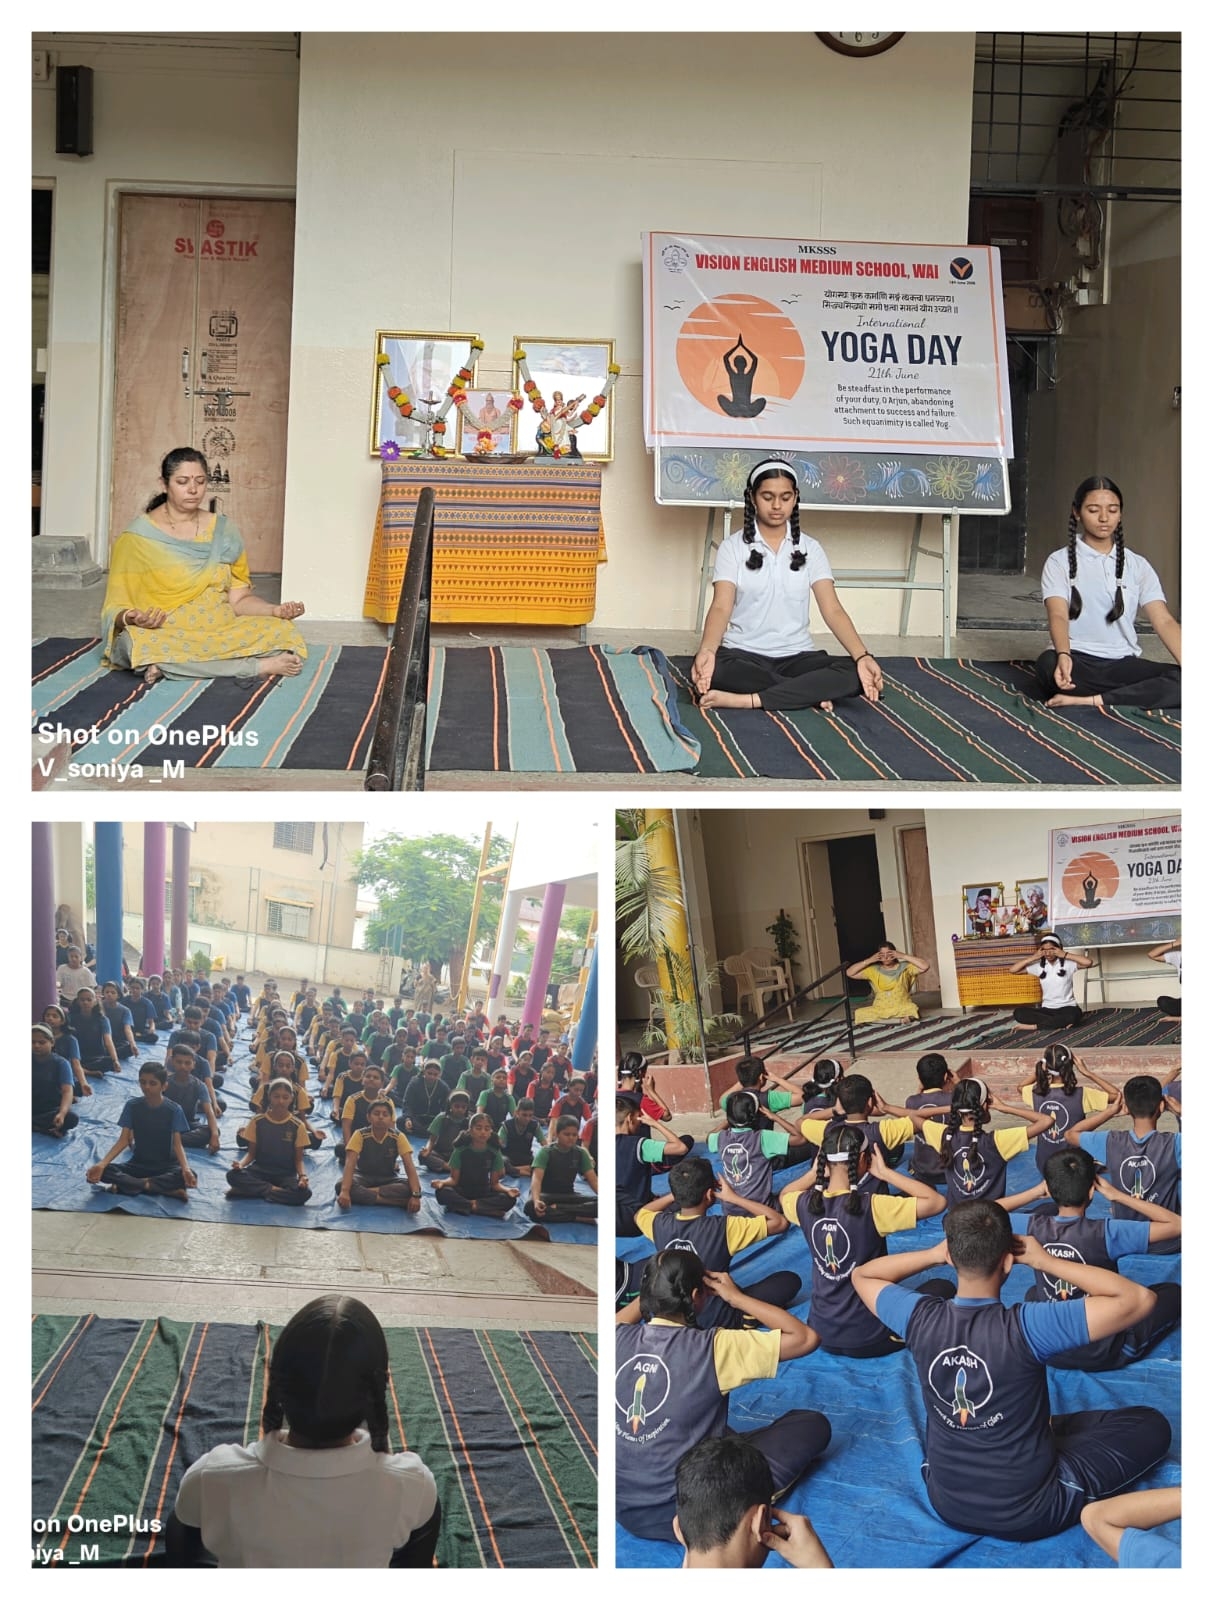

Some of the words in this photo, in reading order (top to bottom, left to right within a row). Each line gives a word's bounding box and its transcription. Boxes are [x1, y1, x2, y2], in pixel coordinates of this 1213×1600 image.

[798, 245, 837, 255] MKSSS
[695, 254, 740, 270] VISION
[743, 256, 797, 273] ENGLISH
[800, 258, 853, 275] MEDIUM
[856, 261, 910, 279] SCHOOL,
[912, 263, 939, 279] WAI
[856, 315, 926, 328] International
[821, 331, 899, 364] YOGA
[907, 333, 962, 366] DAY
[867, 366, 892, 379] 21th
[895, 367, 920, 380] June
[837, 384, 847, 392] Be
[847, 384, 882, 393] steadfast
[883, 385, 891, 393] in
[892, 386, 904, 394] the
[905, 386, 951, 396] performance
[836, 395, 845, 403] of
[845, 396, 861, 405] your
[862, 395, 880, 405] duty,
[888, 397, 910, 406] Arjun,
[911, 397, 954, 408] abandoning
[834, 406, 877, 415] attachment
[886, 408, 915, 416] success
[916, 408, 930, 416] and
[843, 417, 861, 425] Such
[862, 418, 904, 428] equanimity
[905, 418, 912, 427] is
[913, 419, 934, 427] called
[1071, 834, 1091, 843] VISION
[1093, 832, 1118, 841] ENGLISH
[1119, 829, 1143, 838] MEDIUM
[1127, 860, 1163, 878] YOGA
[942, 1355, 978, 1369] AKASH
